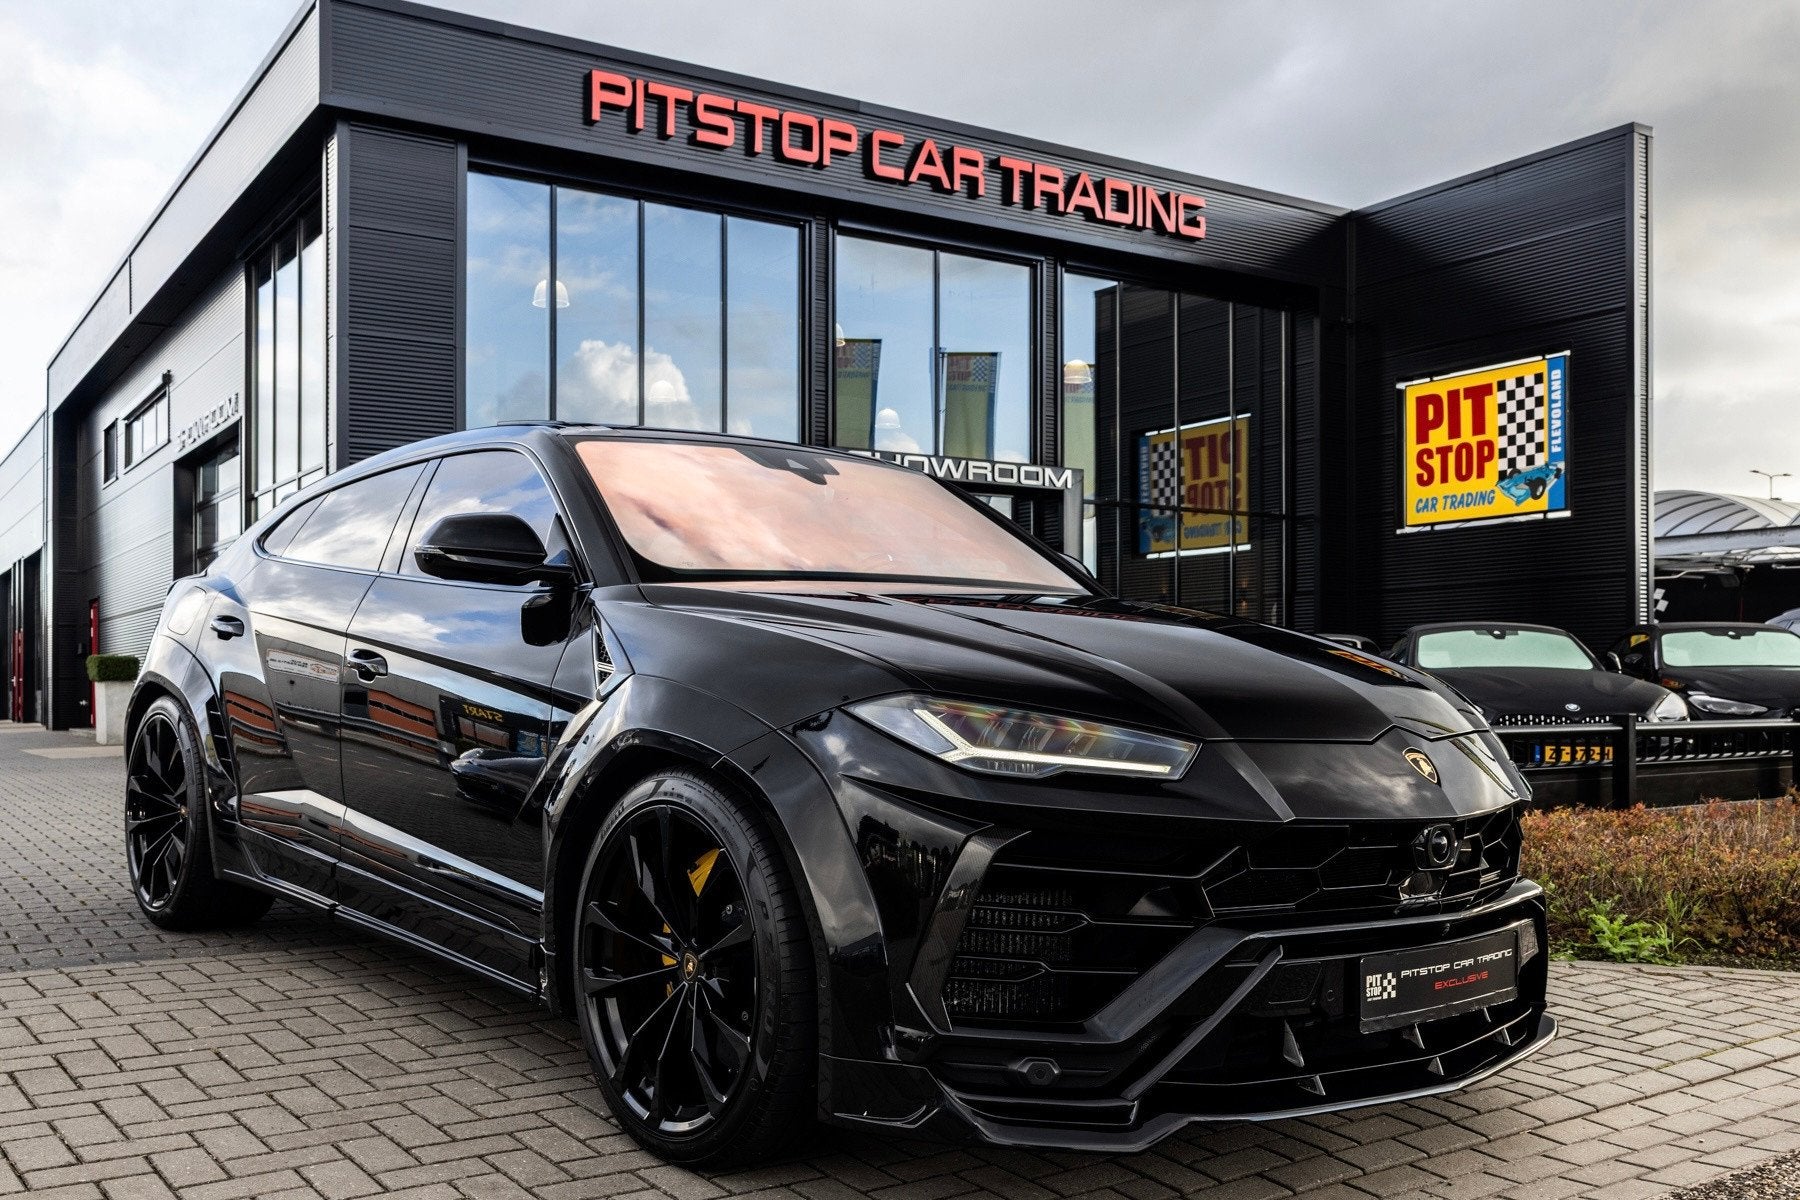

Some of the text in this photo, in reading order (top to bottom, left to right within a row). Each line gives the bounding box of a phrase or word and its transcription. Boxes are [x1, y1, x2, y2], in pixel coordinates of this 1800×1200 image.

[585, 69, 1207, 239] PITSTOP CAR TRADING
[1415, 382, 1494, 445] PIT
[1551, 368, 1562, 453] FLEVOLAND
[848, 451, 1073, 489] OWROOM
[1416, 439, 1495, 488] STOP
[1415, 489, 1496, 514] CAR TRADING
[1366, 973, 1382, 988] PIT
[1401, 948, 1513, 979] PITSTOP CAR TRADING
[1434, 971, 1489, 990] EXCLUSIVE
[1366, 986, 1382, 997] STOP
